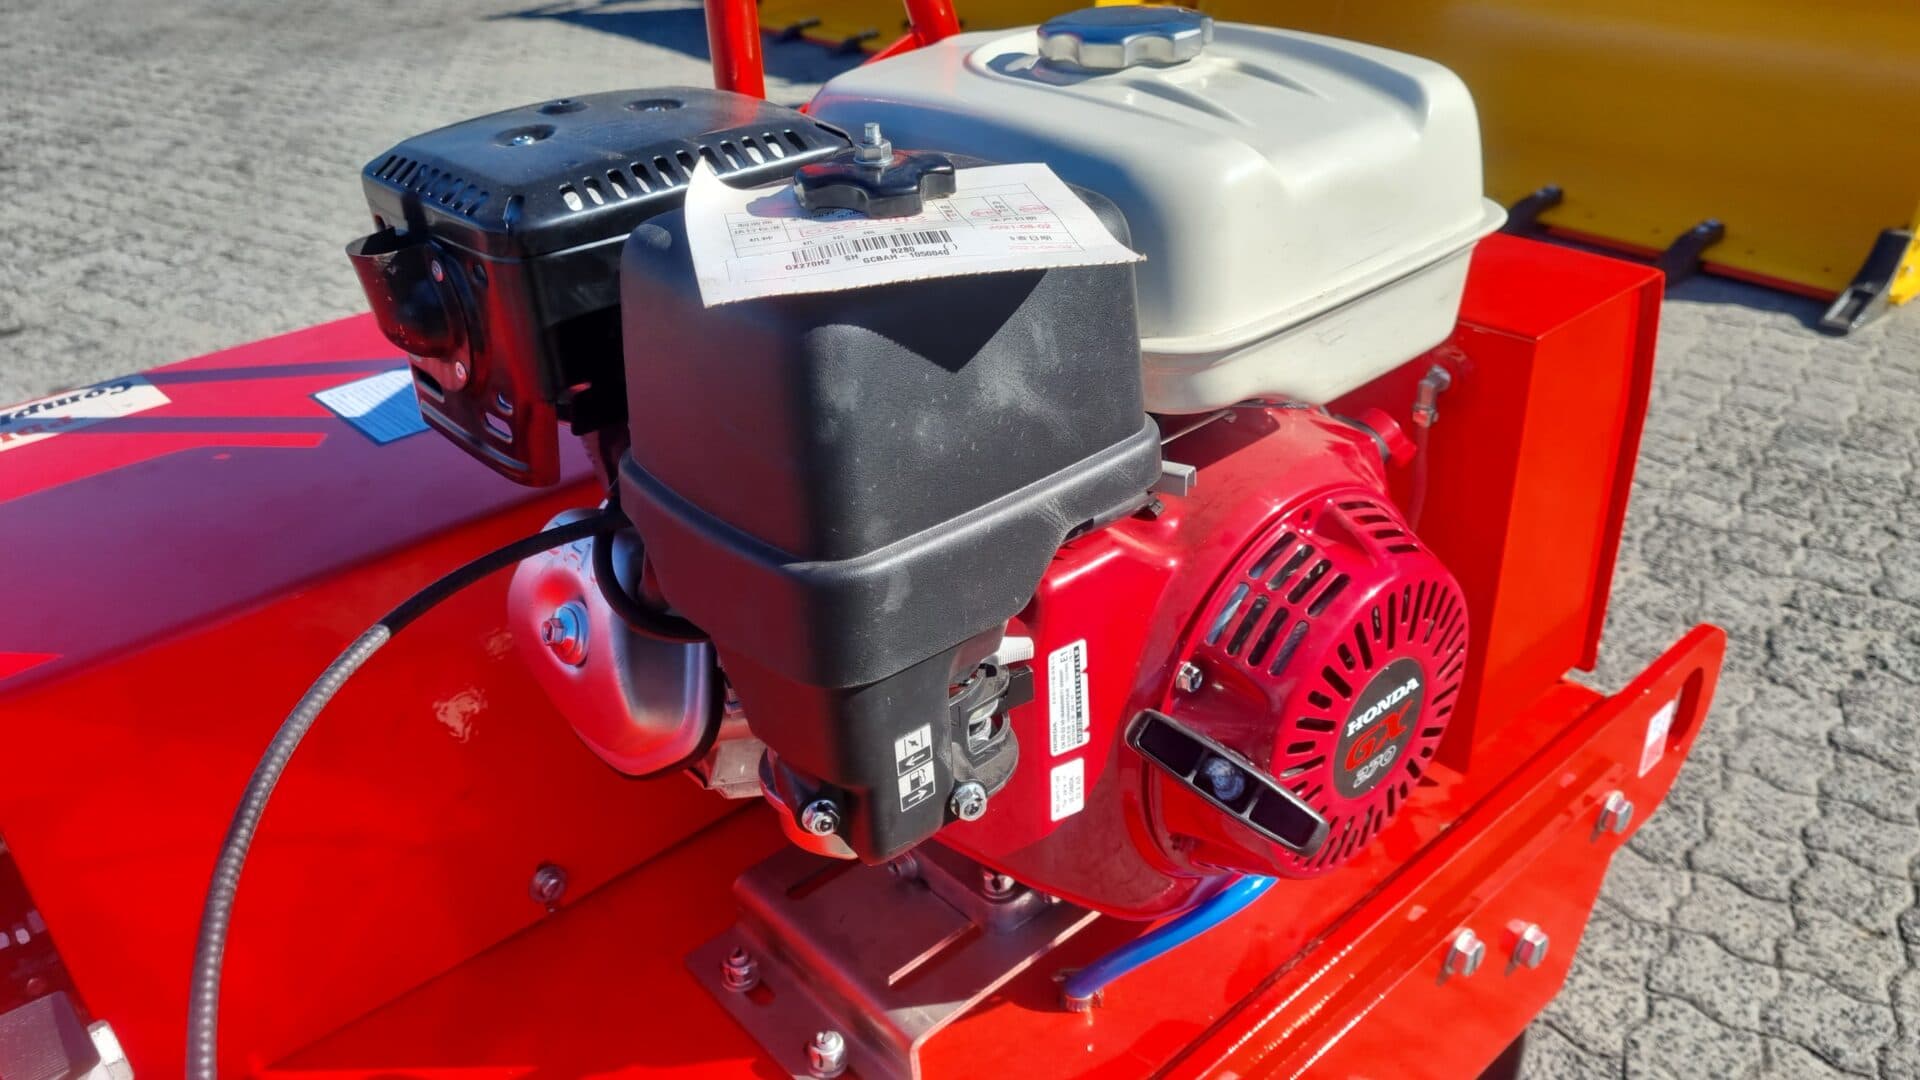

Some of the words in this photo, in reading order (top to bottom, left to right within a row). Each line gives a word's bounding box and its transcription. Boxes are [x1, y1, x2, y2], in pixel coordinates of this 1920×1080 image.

[1344, 699, 1414, 772] GX
[1346, 677, 1420, 738] HONDA
[1352, 744, 1397, 789] 270
